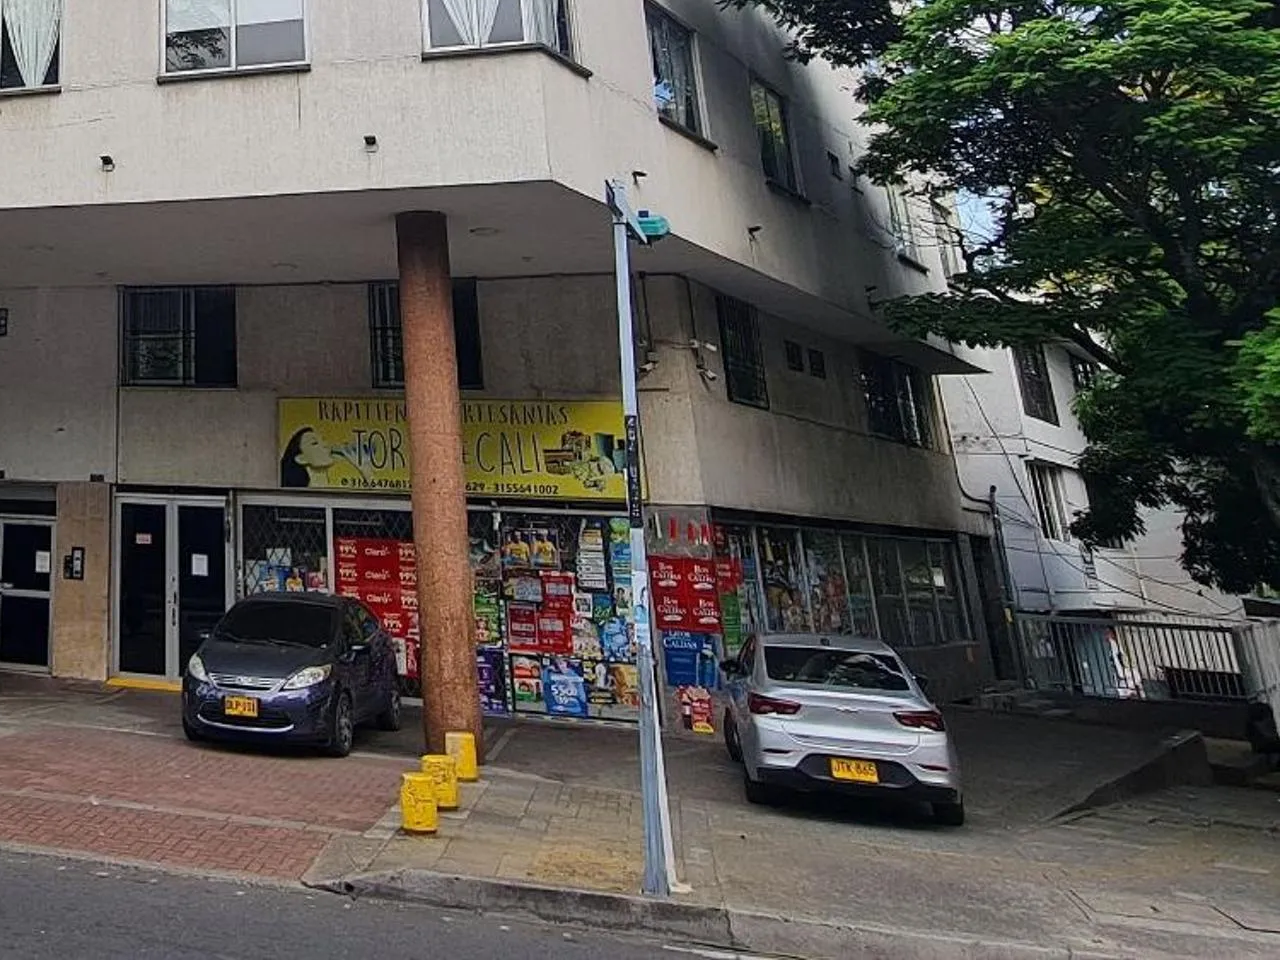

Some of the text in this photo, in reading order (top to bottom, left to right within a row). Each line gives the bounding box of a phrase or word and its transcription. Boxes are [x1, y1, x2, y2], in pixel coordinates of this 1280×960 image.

[318, 400, 568, 426] RAPITIEN RTESANIAS
[352, 427, 406, 471] TOR
[475, 431, 542, 477] CALI
